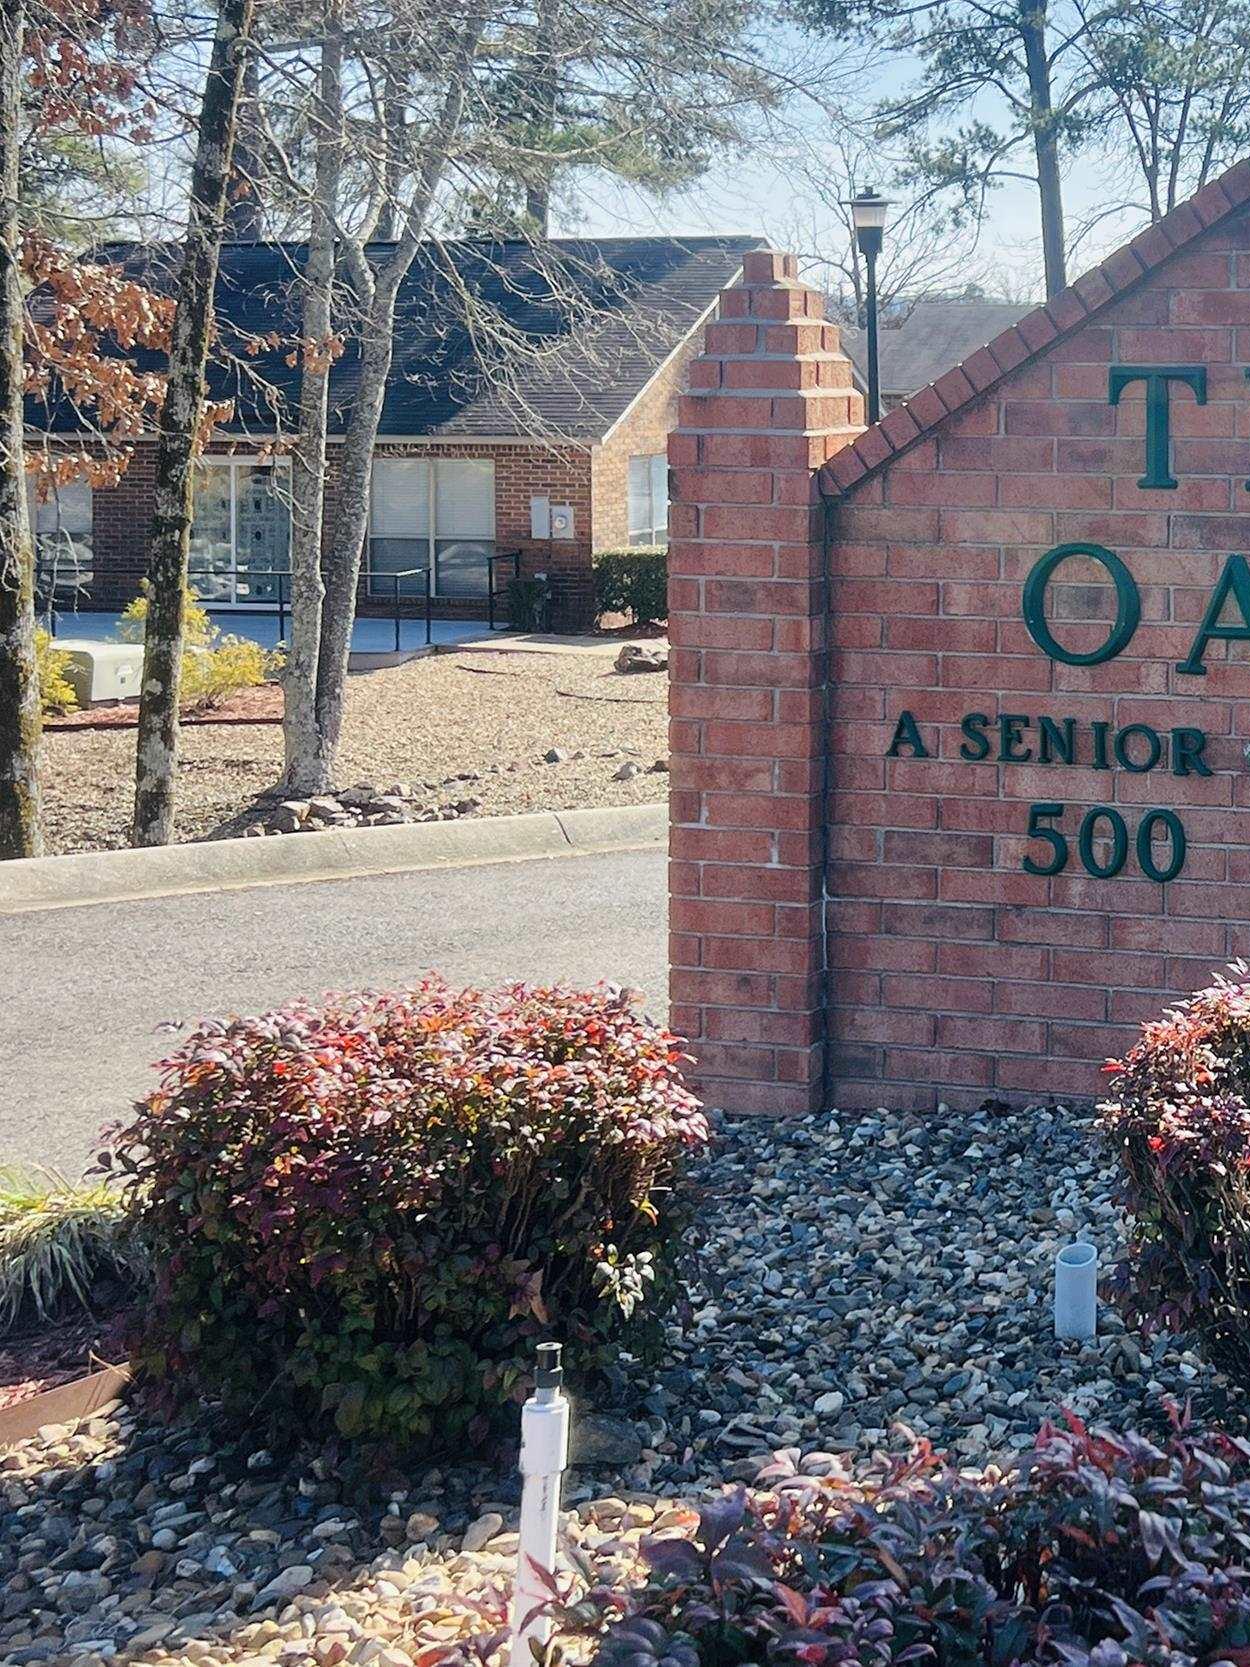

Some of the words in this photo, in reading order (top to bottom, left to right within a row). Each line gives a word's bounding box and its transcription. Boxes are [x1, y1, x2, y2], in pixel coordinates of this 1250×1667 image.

[886, 710, 928, 758] A
[960, 713, 1213, 776] SENIOR
[1022, 804, 1186, 882] 500
